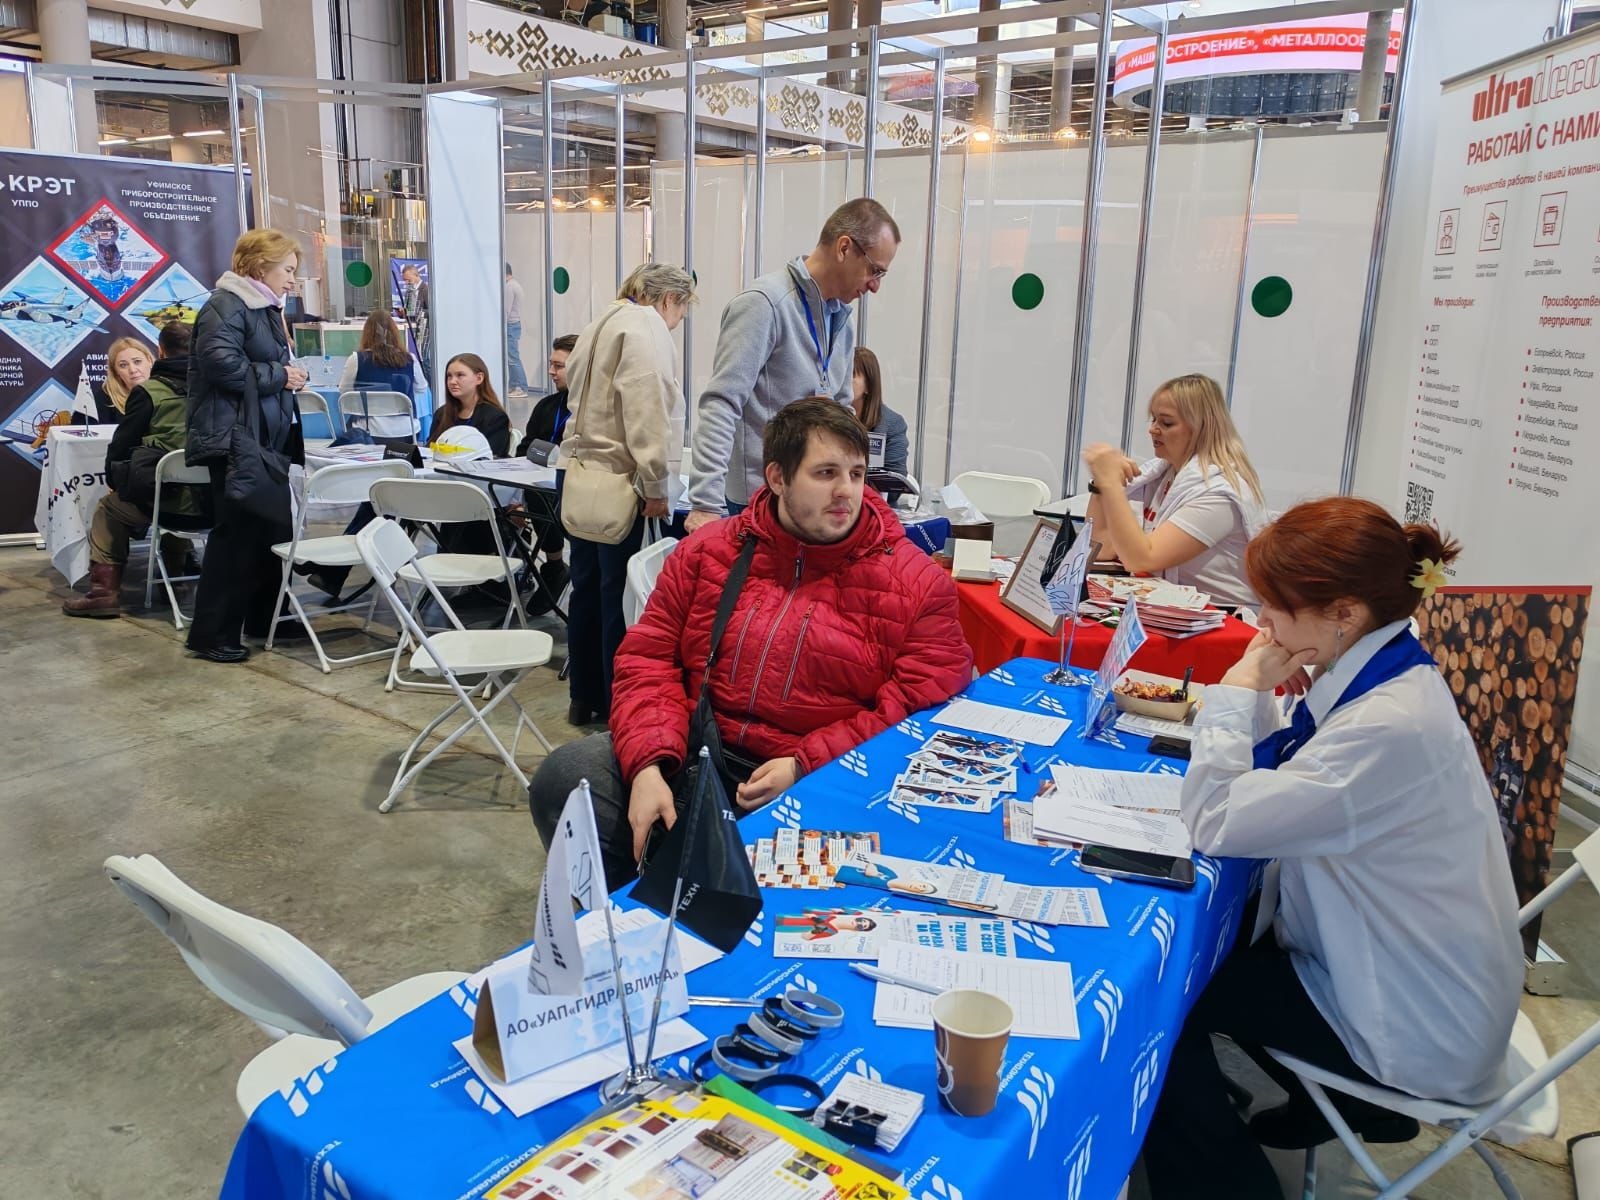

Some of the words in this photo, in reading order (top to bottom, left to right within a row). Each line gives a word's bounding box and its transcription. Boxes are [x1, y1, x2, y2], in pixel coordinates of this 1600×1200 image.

[1128, 40, 1259, 69] «МАШИОСТРОЕНИЕ»,
[1466, 123, 1533, 166] РАБОТАЙ
[1536, 123, 1548, 150] С
[8, 174, 76, 196] КРЭТ
[146, 181, 193, 191] УФИМСКОЕ
[1463, 179, 1506, 197] Преимущества
[1506, 172, 1537, 190] работы
[1543, 166, 1566, 182] нашей
[121, 189, 218, 203] ПРИБОРОСТРОИТЕЛЬНОЕ
[11, 199, 39, 208] УППО
[129, 200, 213, 213] ПРОИЗВОДСТВЕННОЕ
[143, 211, 201, 222] ОБЪЕДИНЕНИЕ
[1541, 295, 1600, 309] Производстве
[1539, 315, 1592, 328] предприятия:
[86, 353, 109, 361] АВИА
[1564, 349, 1585, 360] Россия
[1573, 367, 1594, 379] Россия
[1542, 383, 1562, 393] Россия
[1557, 401, 1578, 413] Россия
[1557, 418, 1579, 431] Россия
[1549, 434, 1571, 447] Россия
[1547, 450, 1574, 466] Беларусь
[1541, 466, 1568, 482] Беларусь
[63, 473, 107, 494] КРЭТ
[1533, 481, 1560, 499] Беларусь
[722, 809, 737, 822] ТЕ
[678, 882, 701, 911] ТЕХН
